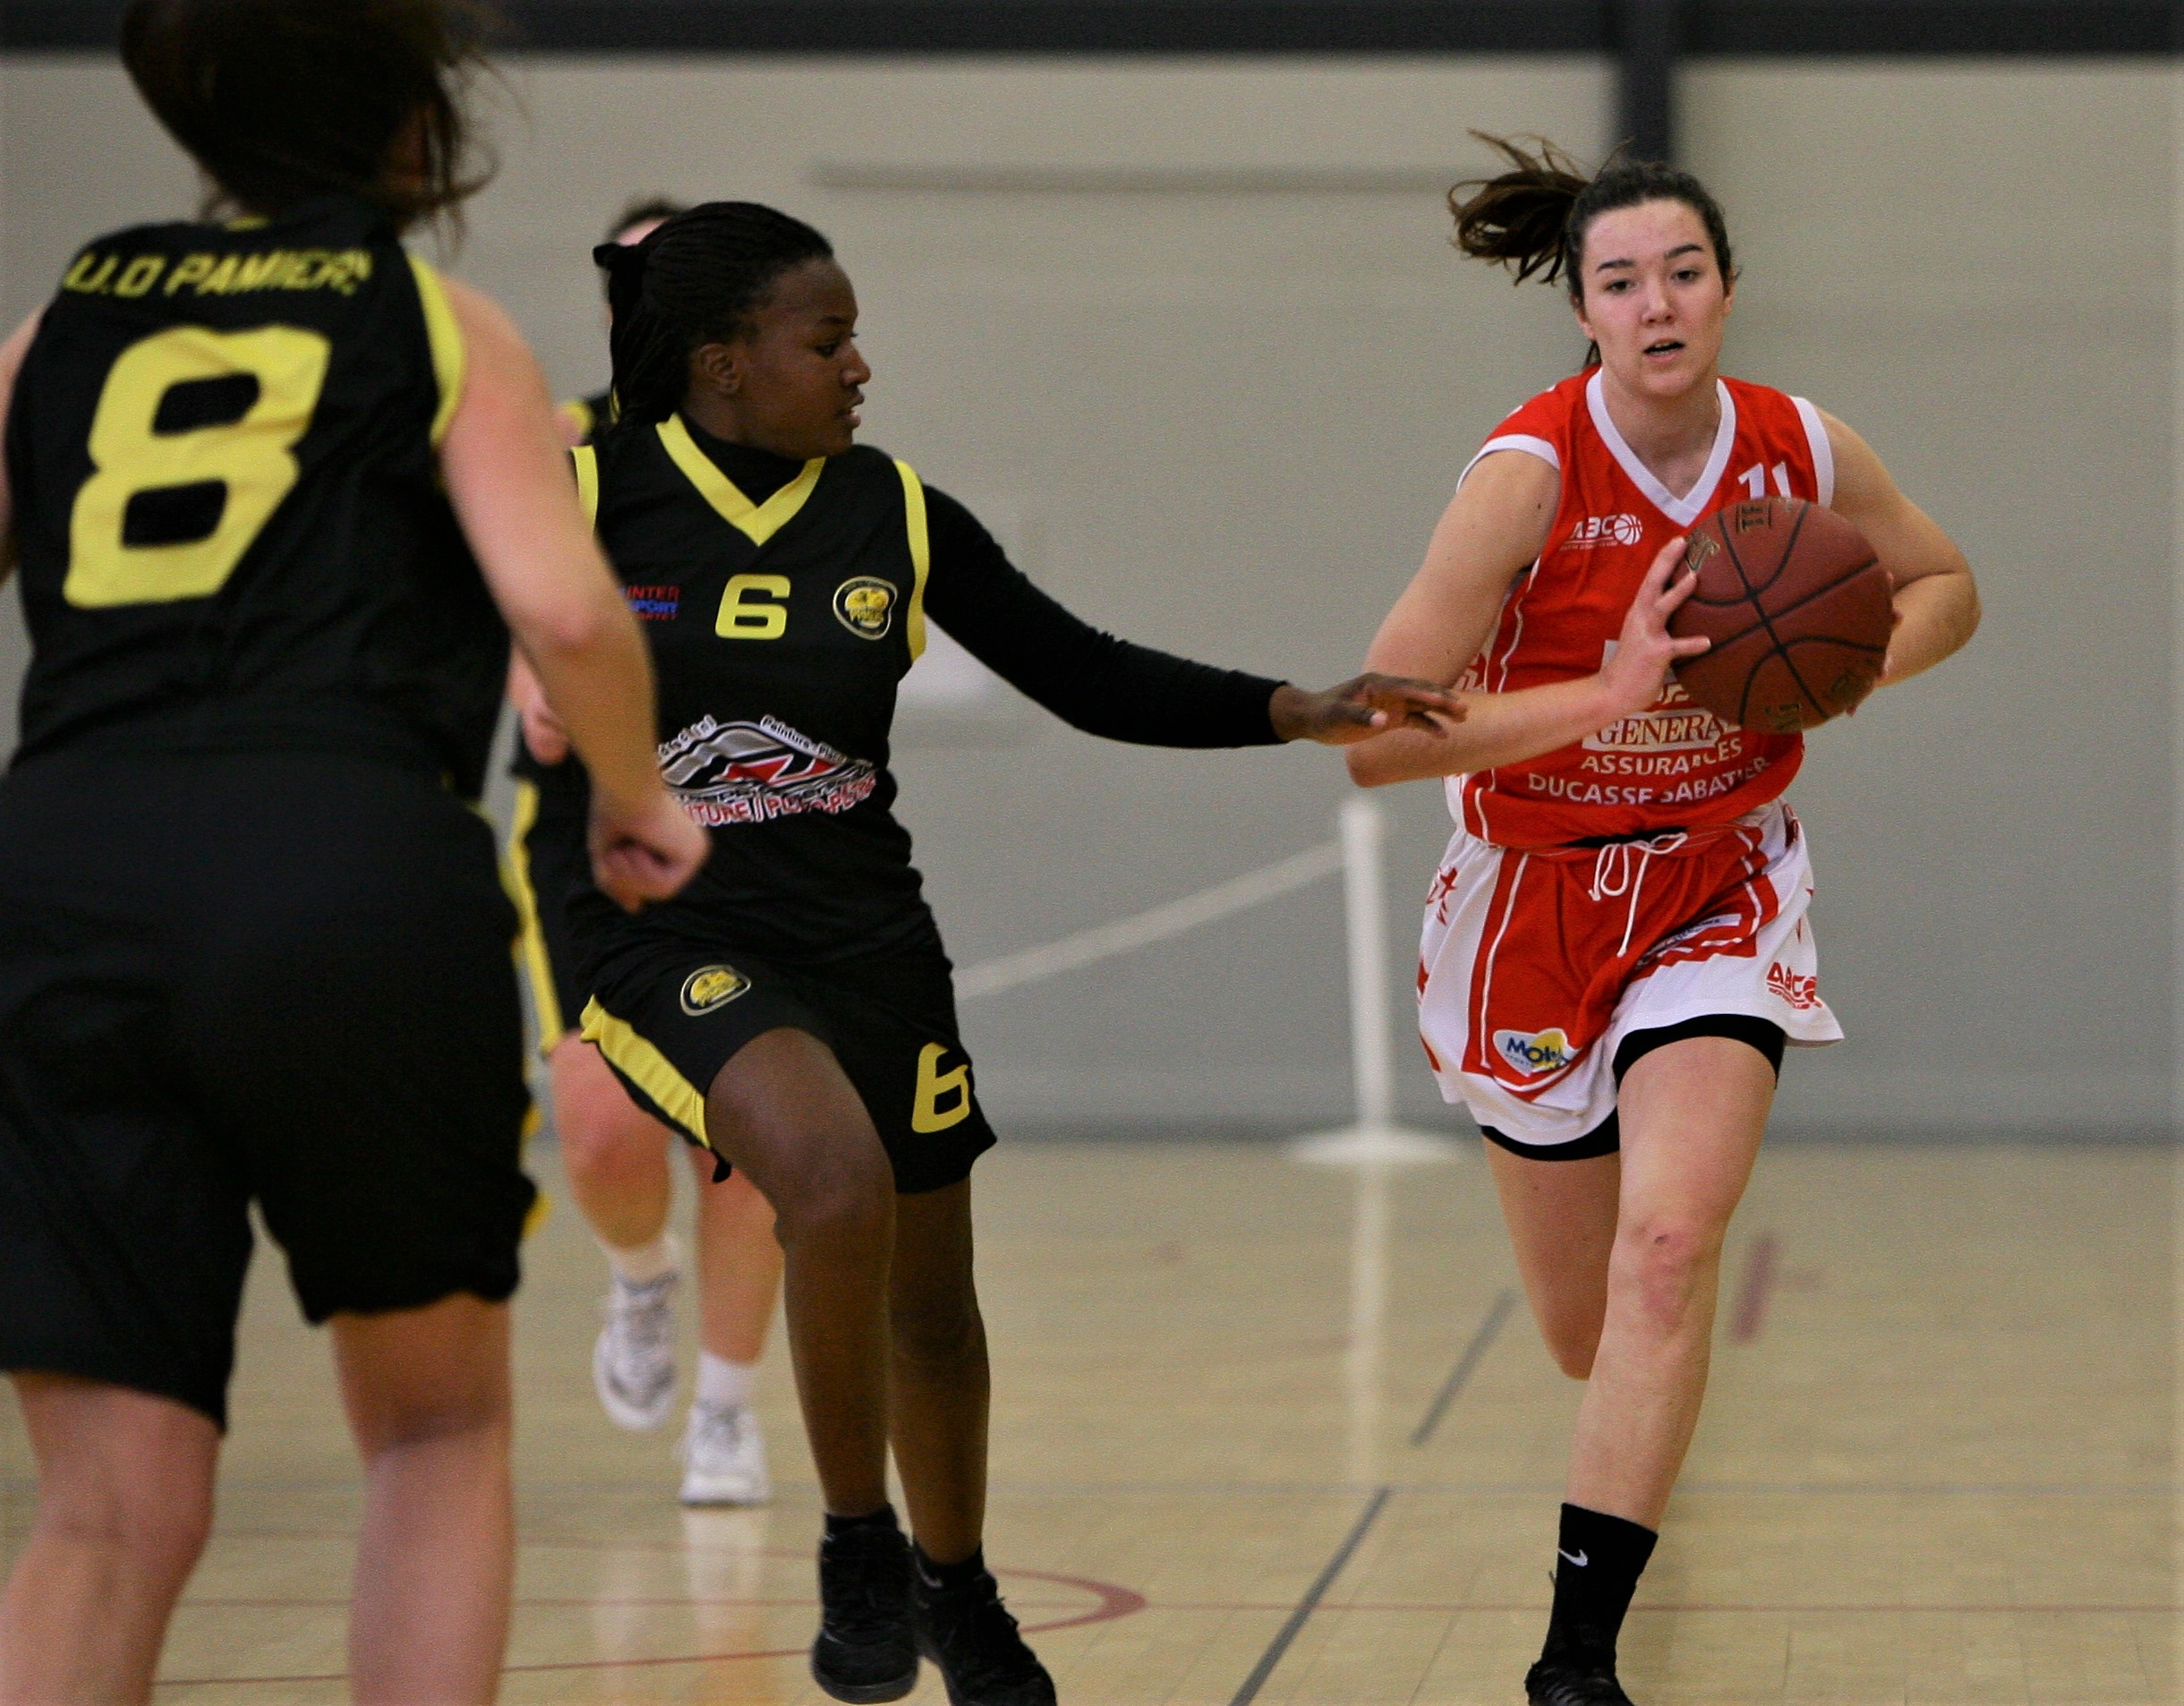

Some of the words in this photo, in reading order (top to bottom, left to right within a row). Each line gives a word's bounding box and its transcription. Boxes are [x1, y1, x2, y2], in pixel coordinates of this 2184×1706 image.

[63, 323, 332, 610] 8
[1737, 461, 1791, 500] 11
[715, 574, 791, 640] 6
[911, 1041, 971, 1133] 6
